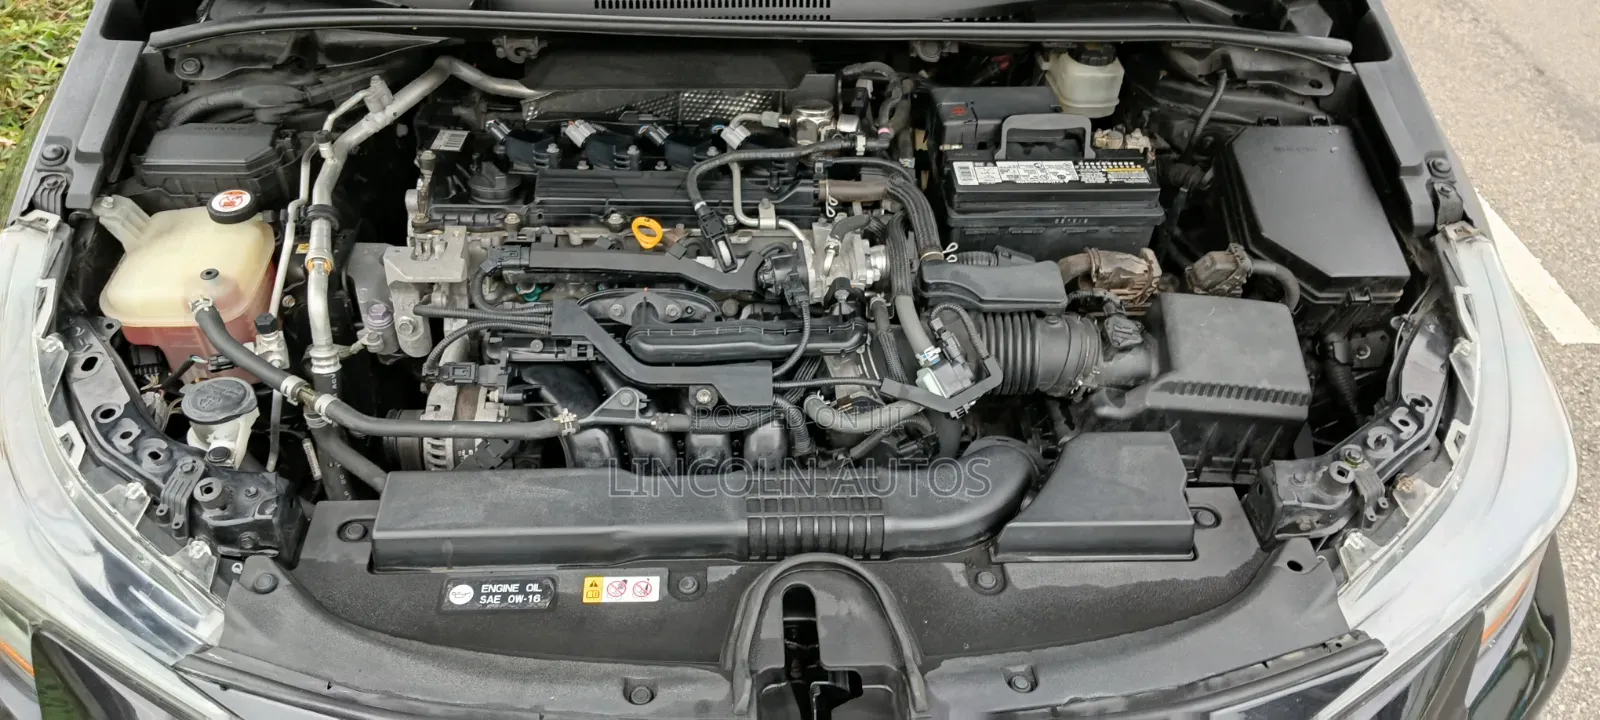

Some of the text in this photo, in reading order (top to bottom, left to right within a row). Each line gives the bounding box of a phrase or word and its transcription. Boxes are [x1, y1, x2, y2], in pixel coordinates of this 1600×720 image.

[481, 583, 543, 593] ENGINE OIL
[479, 594, 541, 604] SAE 0W-16
